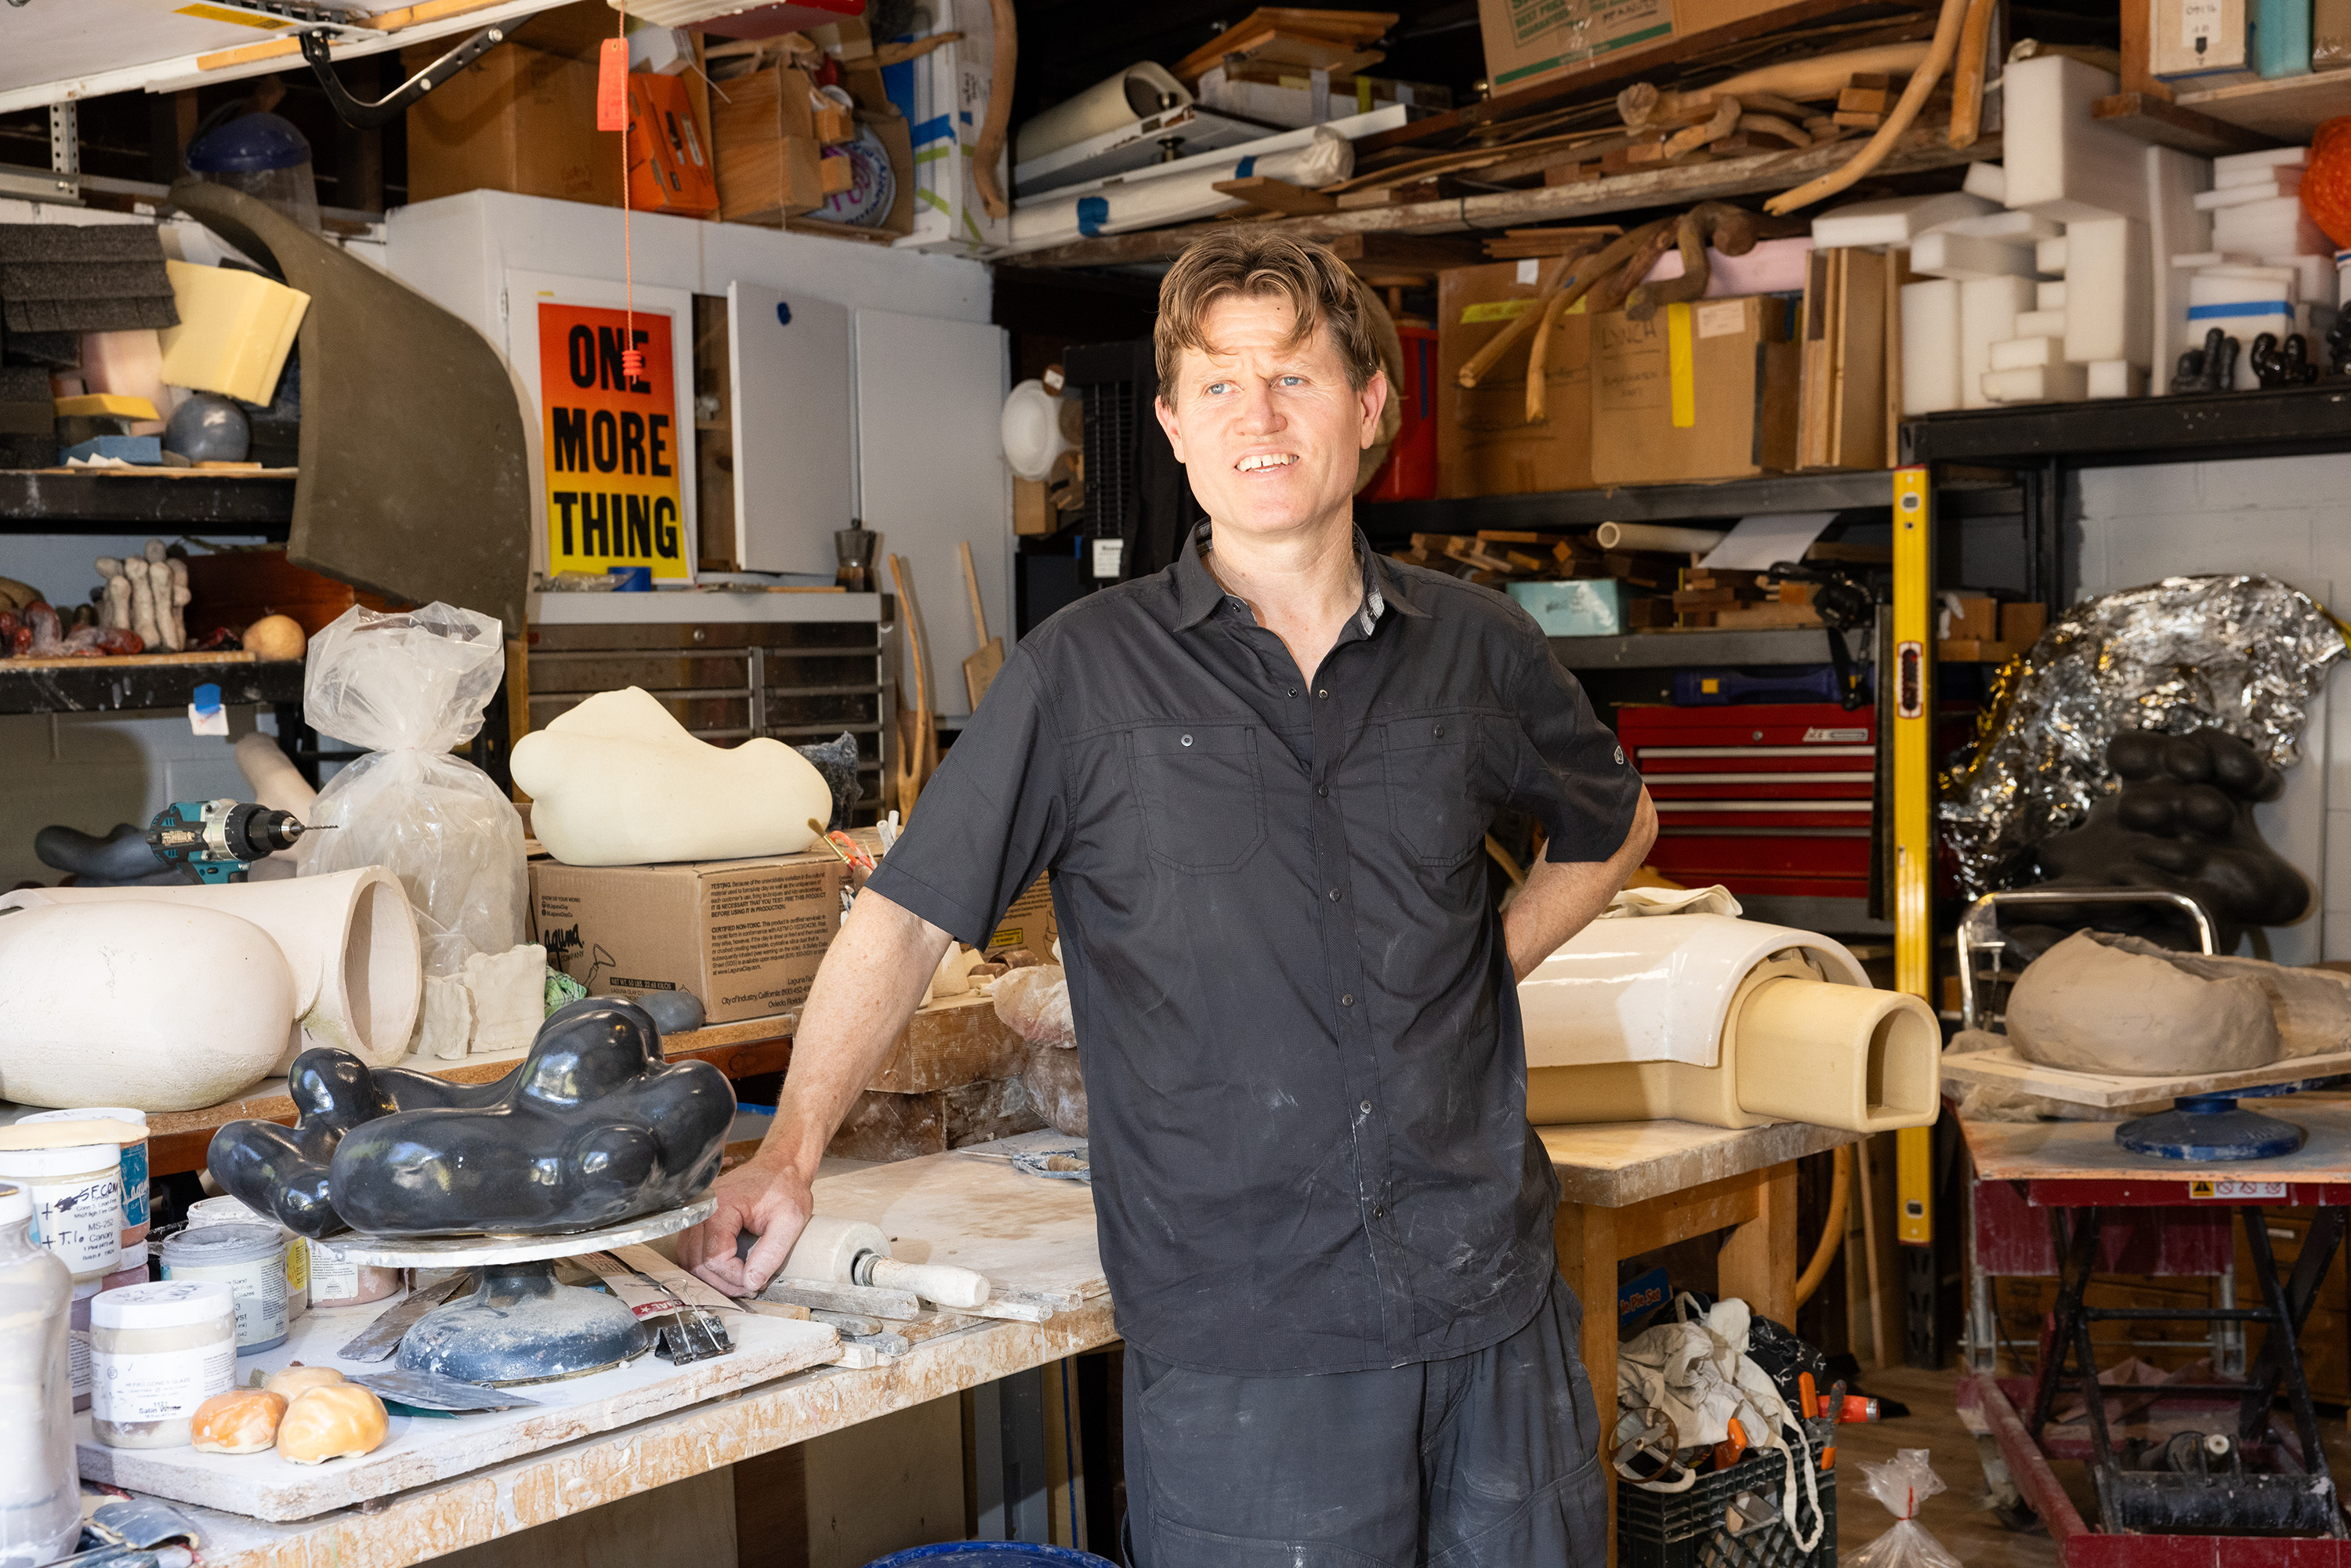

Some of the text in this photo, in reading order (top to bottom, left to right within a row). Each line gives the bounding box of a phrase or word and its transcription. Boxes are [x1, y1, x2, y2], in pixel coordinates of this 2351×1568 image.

[569, 324, 651, 395] ONE
[552, 407, 672, 477] MORE
[553, 491, 679, 559] THING
[561, 949, 584, 962] COMPANY
[788, 977, 806, 986] Laguna
[721, 997, 731, 1005] City
[89, 1219, 114, 1232] MS-252
[89, 1232, 114, 1244] Canary
[1629, 1292, 1645, 1313] Pie
[1645, 1287, 1661, 1306] Set
